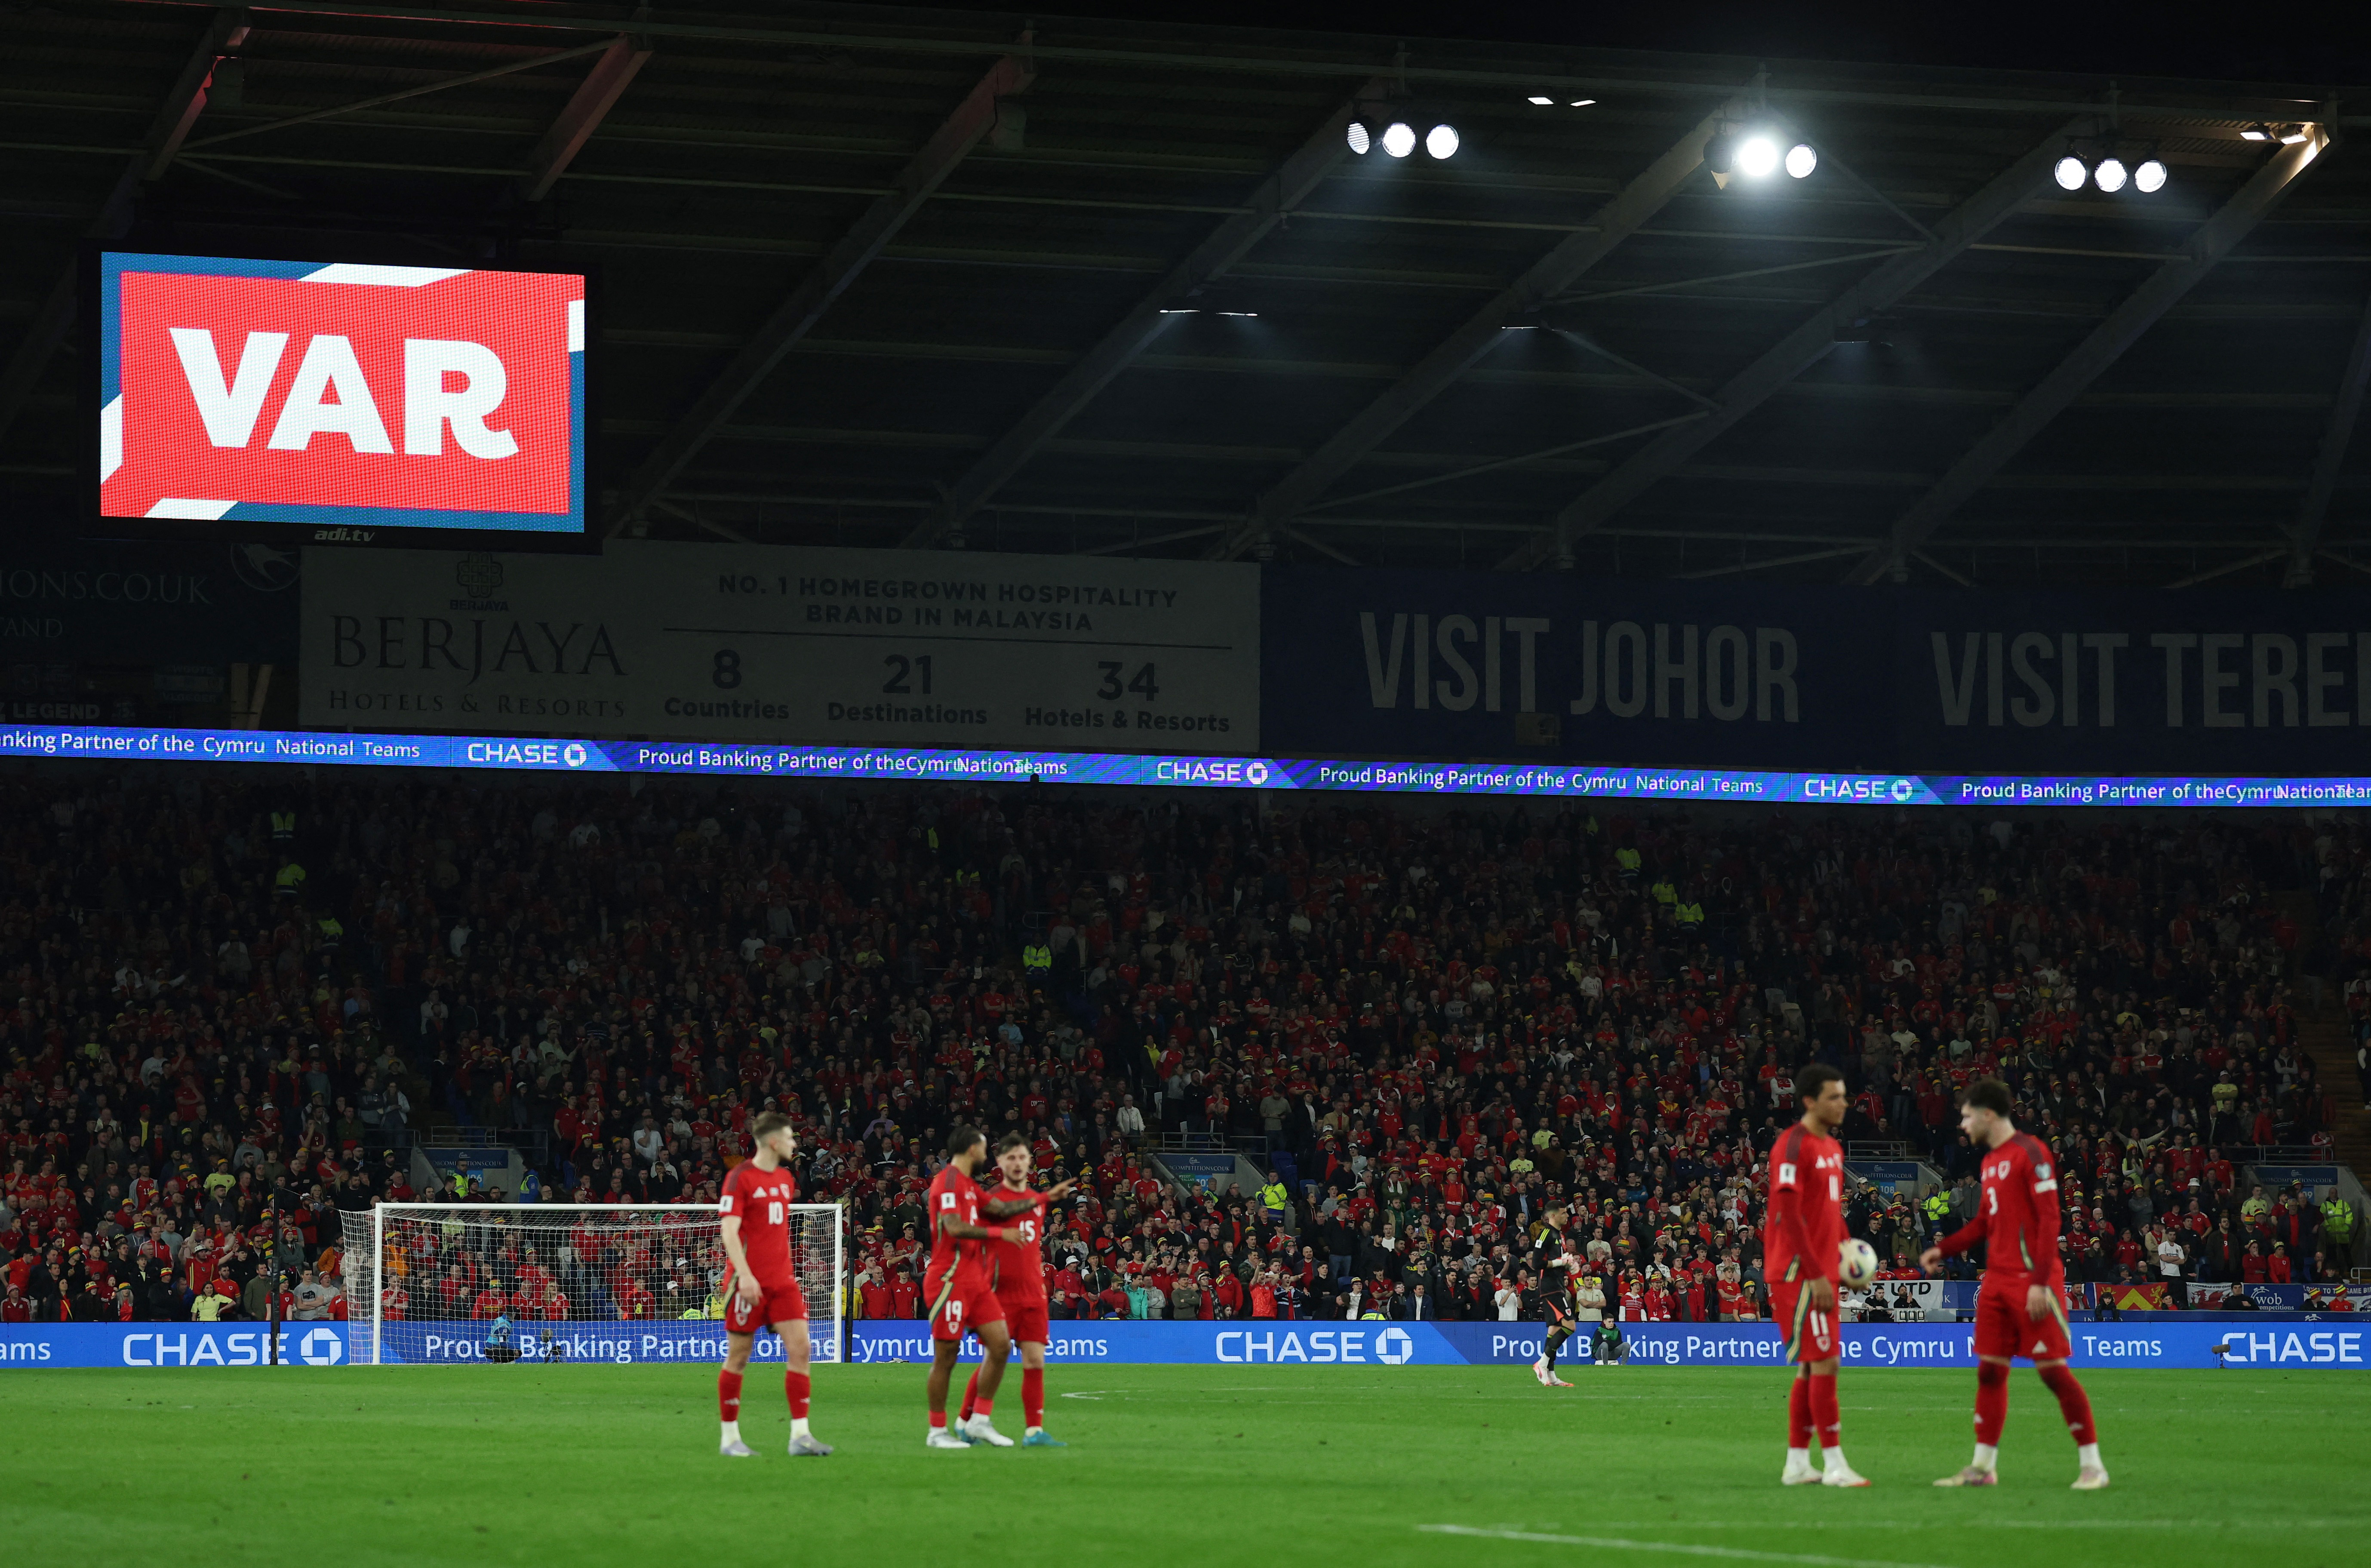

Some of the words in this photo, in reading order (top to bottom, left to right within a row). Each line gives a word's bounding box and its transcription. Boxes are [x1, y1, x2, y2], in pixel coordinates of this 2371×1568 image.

[169, 327, 520, 460] VAR
[314, 527, 375, 542] adi.tv
[719, 575, 766, 594] NO.
[779, 577, 787, 595] 1
[800, 577, 986, 601] HOMEGROWN
[999, 584, 1177, 608] HOSPITALITY
[450, 599, 509, 612] BERJAYA
[806, 605, 902, 624] BRAND
[915, 608, 941, 626] IN
[954, 609, 1093, 630] MALAYSIA
[0, 617, 63, 638] AND
[330, 615, 629, 686] BERJAYA
[712, 649, 742, 690] 8
[882, 654, 932, 695] 21
[1359, 612, 1549, 713] VISIT
[1570, 620, 1799, 722] JOHOR
[1930, 631, 2129, 727] VISIT
[1097, 661, 1159, 701] 34
[13, 703, 101, 719] LEGEND
[461, 693, 479, 713] &
[664, 697, 790, 720] Countries
[828, 702, 987, 725] Destinations
[1026, 707, 1104, 728] Hotels
[1112, 710, 1129, 729] &
[1137, 710, 1230, 732] Resorts
[0, 731, 56, 753] nking
[62, 733, 134, 750] Partner
[138, 735, 159, 750] of
[163, 735, 194, 752] the
[203, 737, 265, 757] Cymru
[276, 738, 354, 756] National
[362, 742, 420, 757] Teams
[467, 743, 559, 764] CHASE
[639, 749, 693, 766] Proud
[699, 750, 772, 771] Banking
[778, 753, 847, 769] Partner
[853, 753, 871, 770] of
[1157, 761, 1242, 781] CHASE
[1320, 767, 1371, 783] Proud
[1376, 769, 1445, 789] Banking
[1448, 770, 1513, 787] Partner
[1516, 771, 1534, 787] of
[1537, 772, 1565, 787] the
[1571, 774, 1627, 793] Cymru
[1636, 776, 1704, 791] National
[1712, 778, 1763, 793] Teams
[1805, 779, 1887, 798] CHASE
[1962, 783, 2015, 798] Proud
[2021, 783, 2093, 802] Banking
[2099, 783, 2166, 799] Partner
[2172, 783, 2191, 798] of
[1880, 1185, 1894, 1194] 108
[1987, 1187, 1999, 1215] 3
[768, 1201, 784, 1225] 10
[1019, 1220, 1036, 1242] 15
[945, 1300, 963, 1322] 19
[1562, 1297, 1568, 1308] 1
[2255, 1293, 2282, 1305] wob
[1810, 1310, 1829, 1336] 11
[123, 1334, 290, 1366] CHASE
[642, 1334, 730, 1358] Partne
[1215, 1331, 1366, 1362] CHASE
[1577, 1334, 1679, 1364] Bking
[1687, 1335, 1782, 1358] Partner
[1872, 1336, 1954, 1365] Cymru
[2082, 1336, 2162, 1356] Teams
[2222, 1333, 2364, 1362] CHASE
